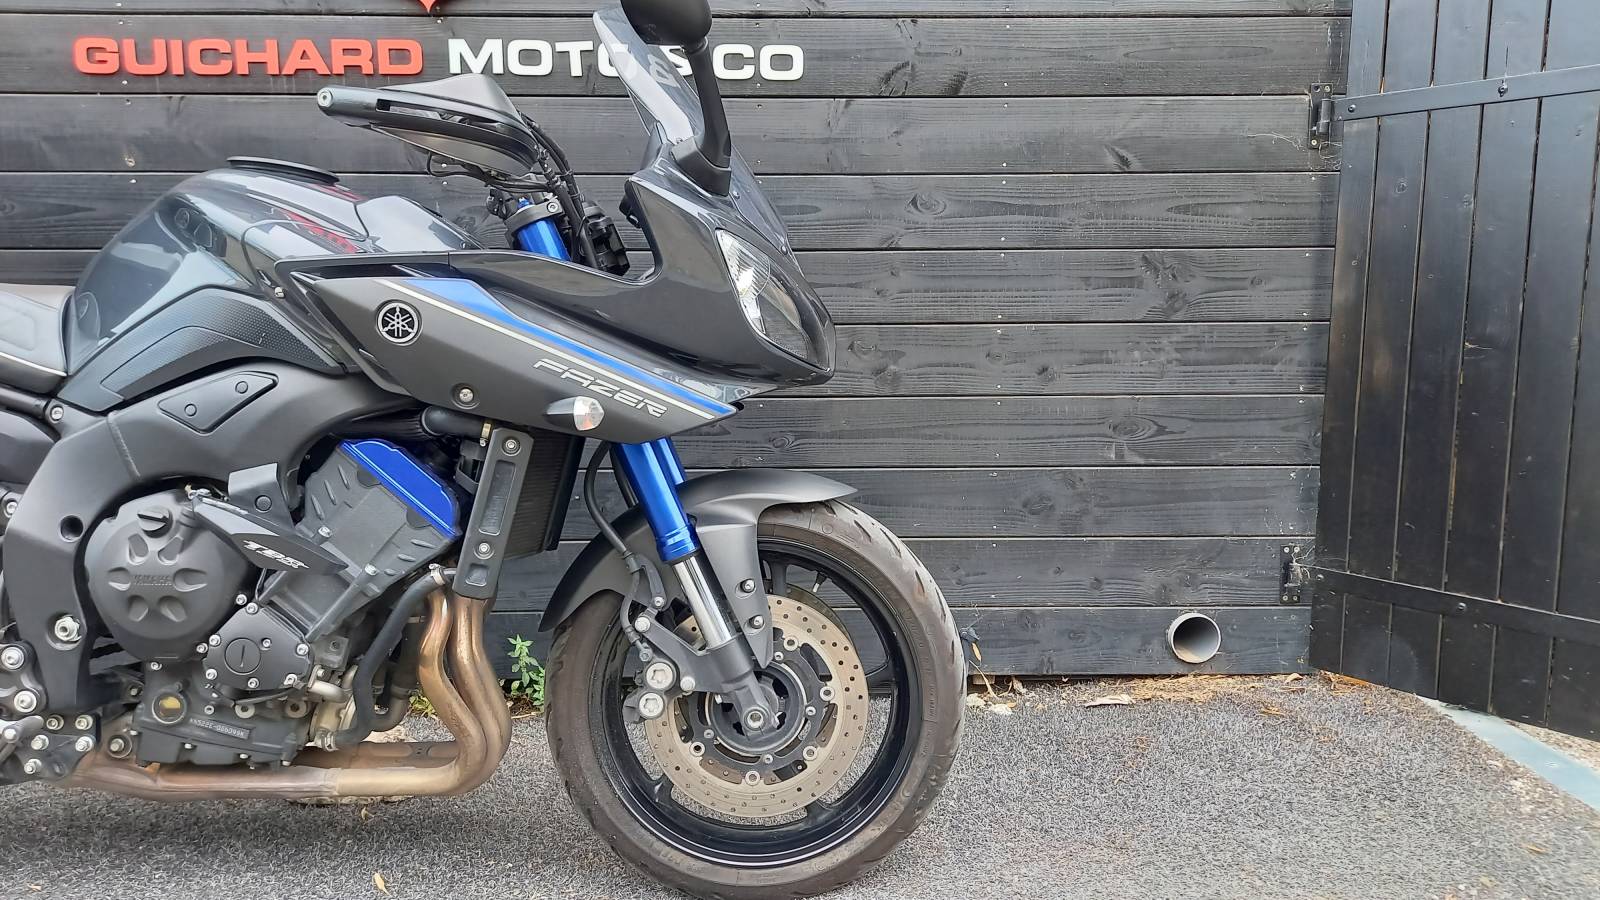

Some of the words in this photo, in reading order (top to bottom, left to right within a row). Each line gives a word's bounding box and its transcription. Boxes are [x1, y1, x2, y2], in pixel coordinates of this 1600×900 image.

[73, 37, 423, 76] GUICHARD
[712, 43, 804, 81] CO
[533, 358, 669, 418] FAZER
